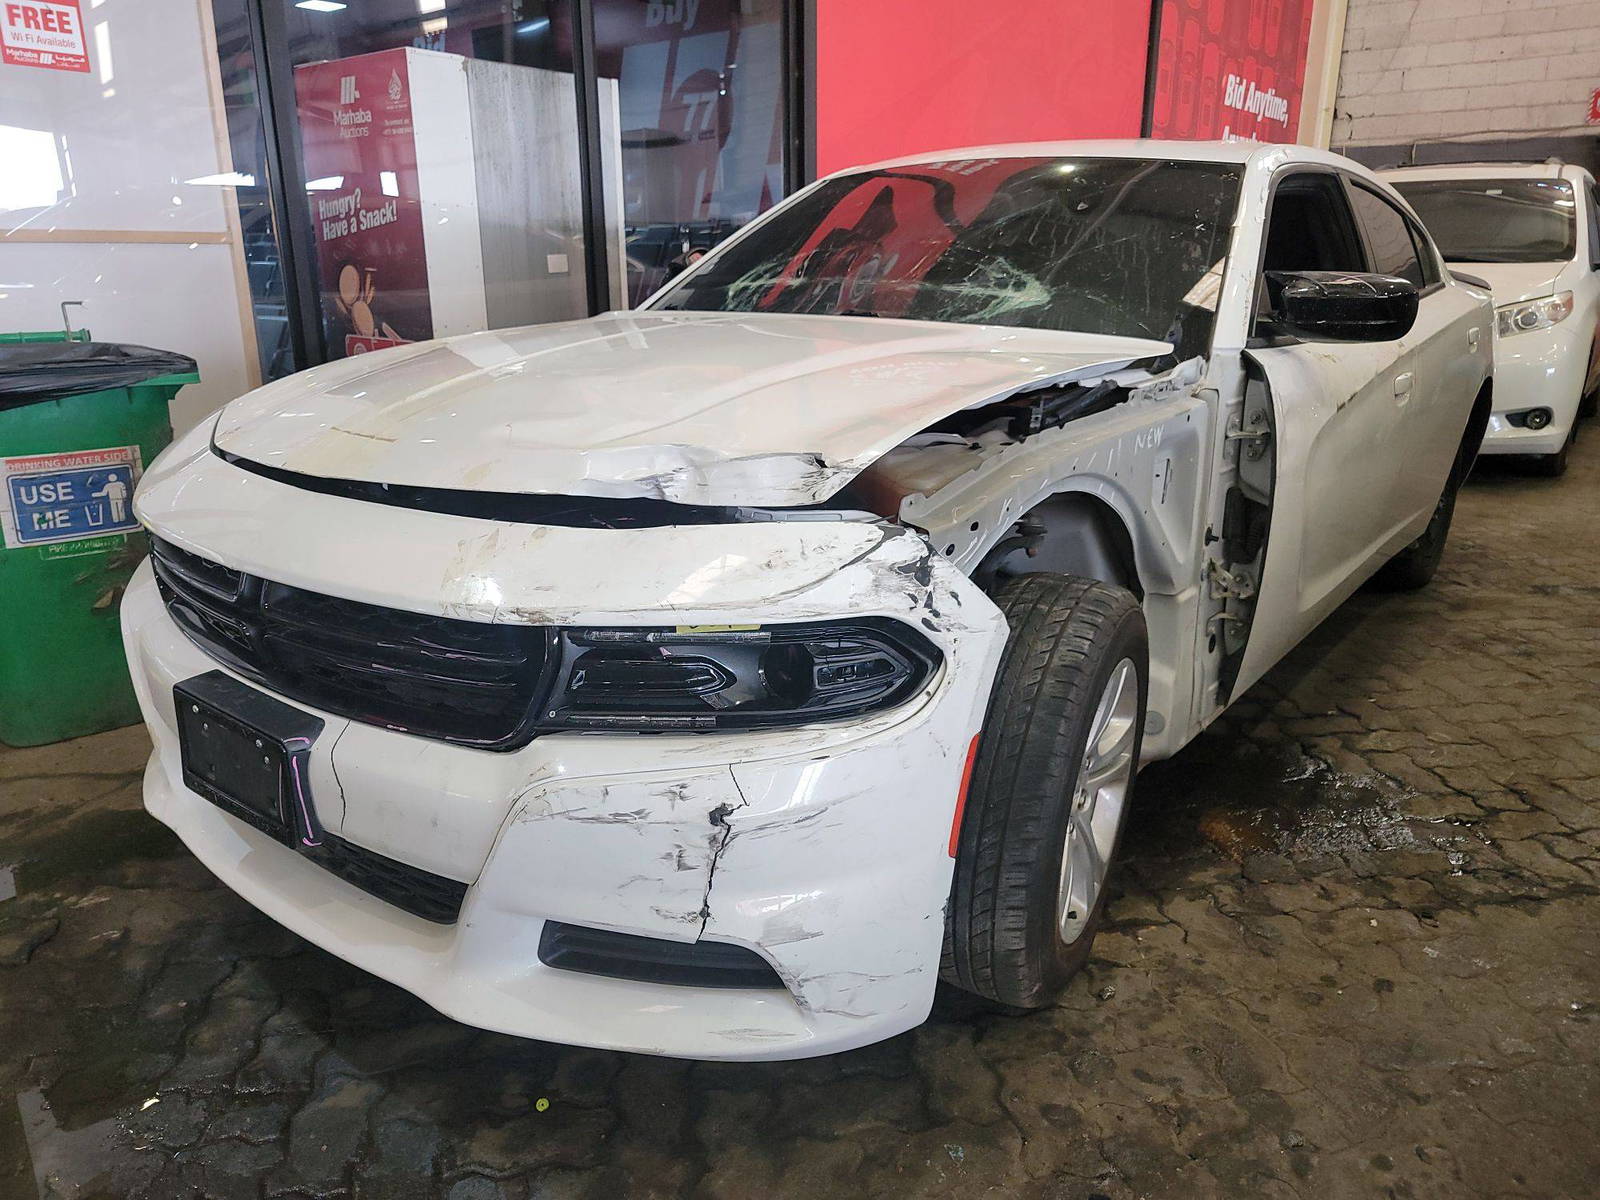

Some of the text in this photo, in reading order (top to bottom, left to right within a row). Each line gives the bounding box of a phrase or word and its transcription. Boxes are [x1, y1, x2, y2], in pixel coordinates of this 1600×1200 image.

[6, 4, 73, 34] FREE
[36, 35, 76, 49] Available
[1224, 73, 1288, 129] Bid Anytime,
[333, 108, 372, 126] Marhaba
[318, 187, 361, 220] Hungry?
[322, 199, 397, 241] Have a Snack!
[1134, 424, 1164, 456] NEW
[7, 451, 130, 472] DRINKING WATER SIDE
[20, 482, 75, 505] USE
[33, 509, 72, 531] ME
